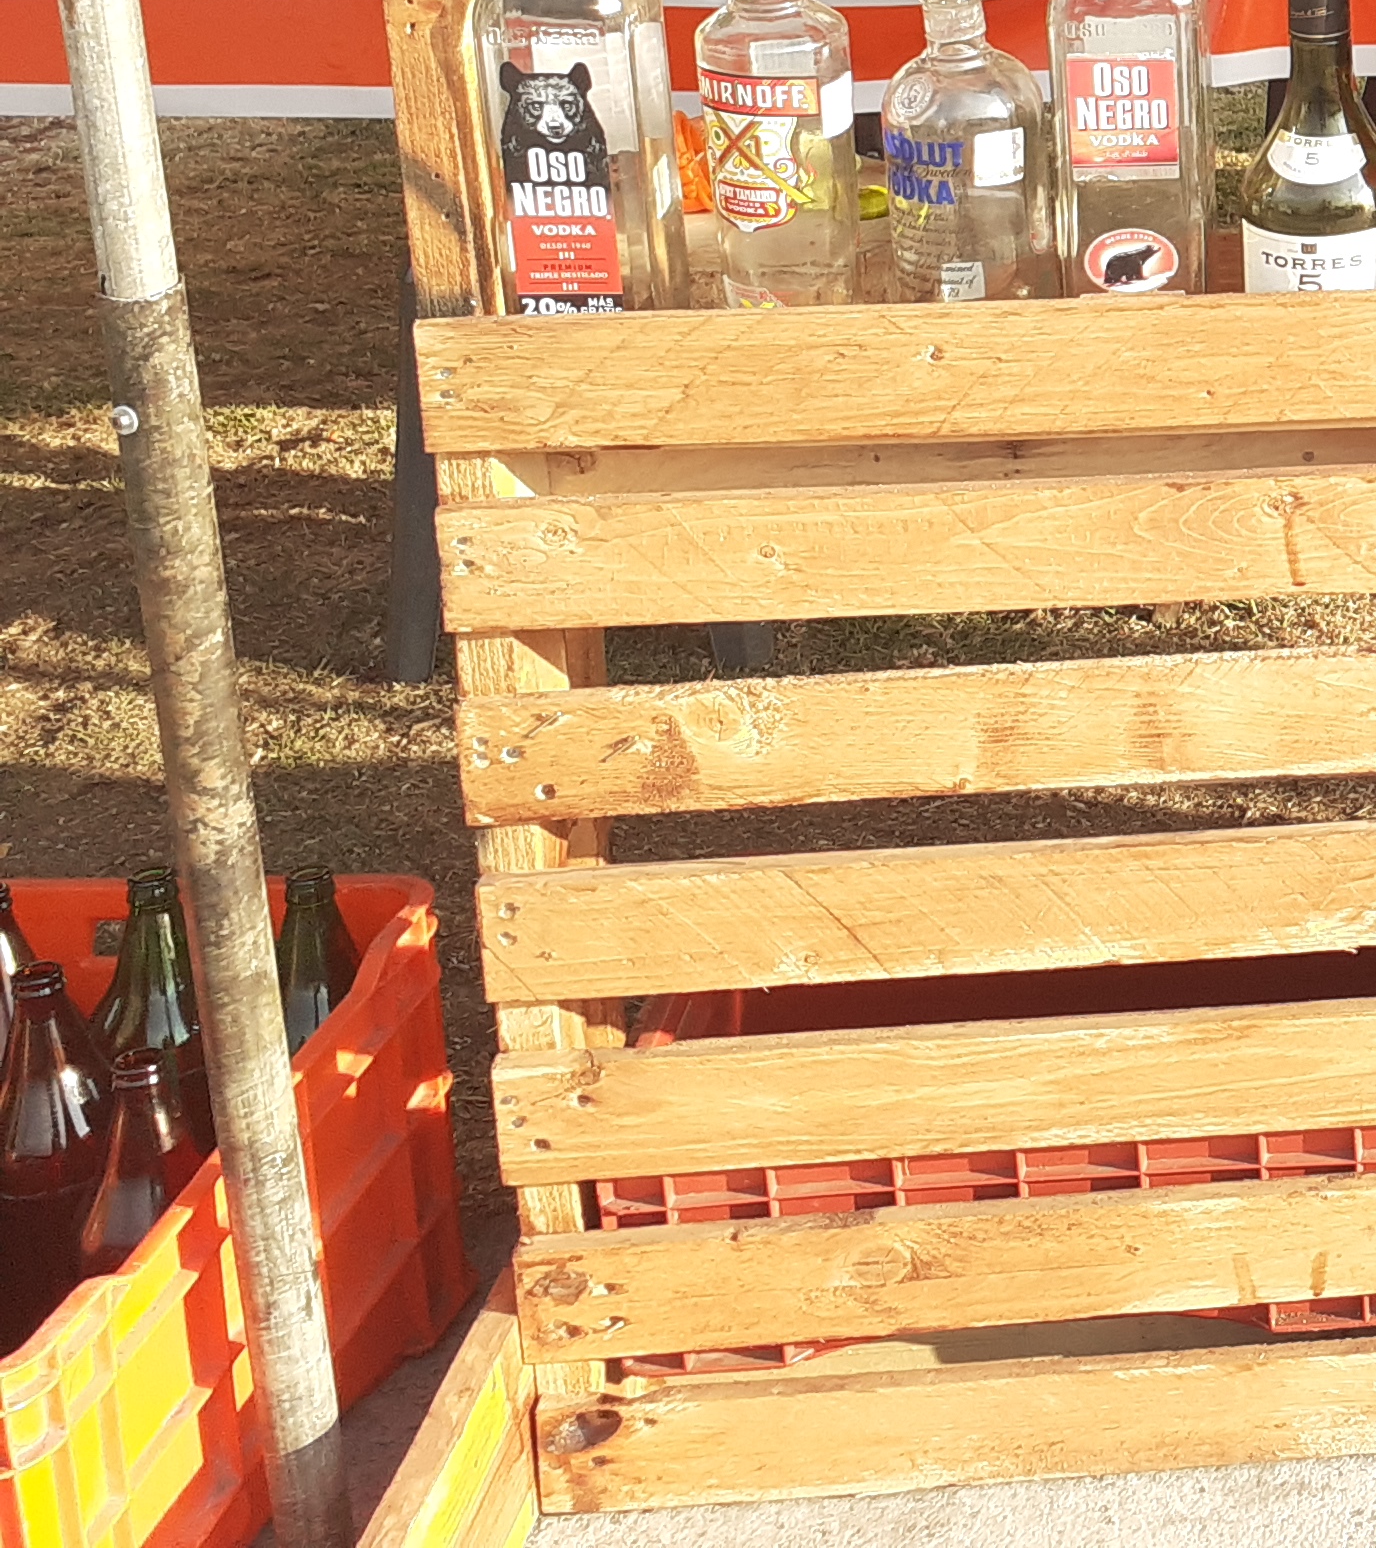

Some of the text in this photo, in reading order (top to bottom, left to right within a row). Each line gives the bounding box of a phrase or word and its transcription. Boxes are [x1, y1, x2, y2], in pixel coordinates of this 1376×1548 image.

[1092, 61, 1150, 97] OSO
[1075, 96, 1171, 131] NEGRO
[1089, 133, 1160, 147] VODKA
[526, 146, 587, 183] OSO
[511, 181, 613, 219] NEGRO
[531, 224, 597, 236] VODKA
[1261, 251, 1364, 271] TORRES
